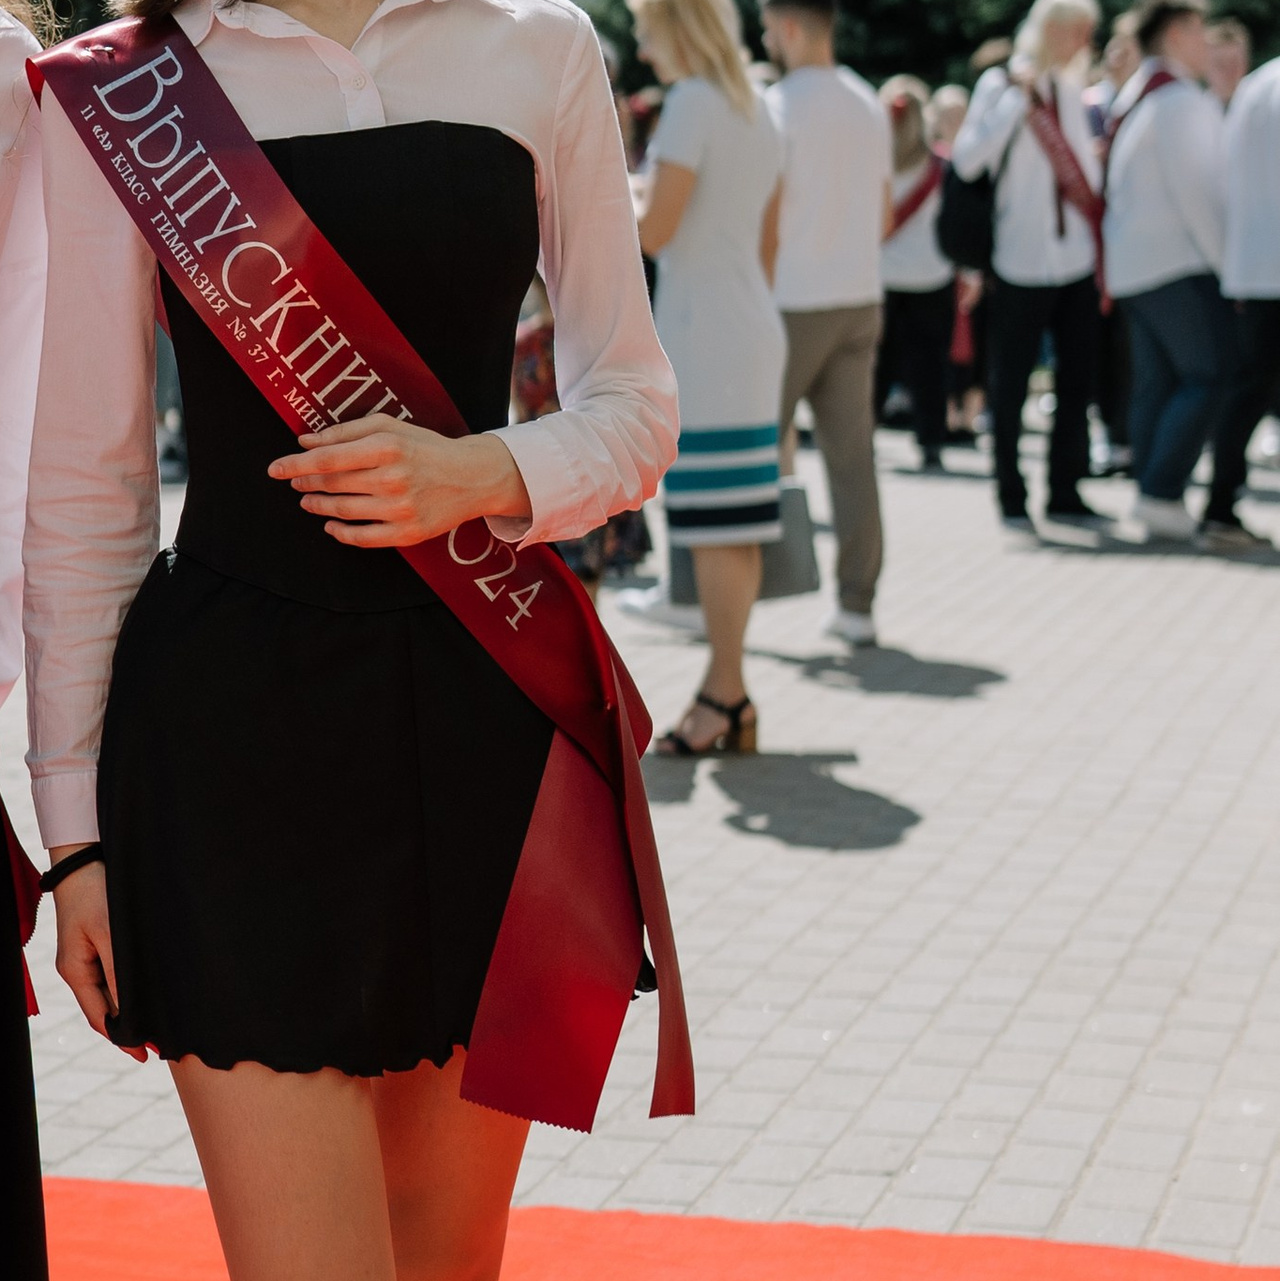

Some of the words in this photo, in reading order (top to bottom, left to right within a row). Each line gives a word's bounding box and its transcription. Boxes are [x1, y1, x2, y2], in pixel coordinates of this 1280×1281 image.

[80, 104, 96, 121] 11
[110, 151, 151, 205] КЛАСС
[150, 210, 231, 316] ГИМНАЗИЯ
[248, 343, 269, 363] 37
[266, 367, 284, 387] Г.
[283, 387, 328, 433] МИН
[93, 45, 413, 423] ВЫПУСКНИ
[448, 528, 544, 632] 024
